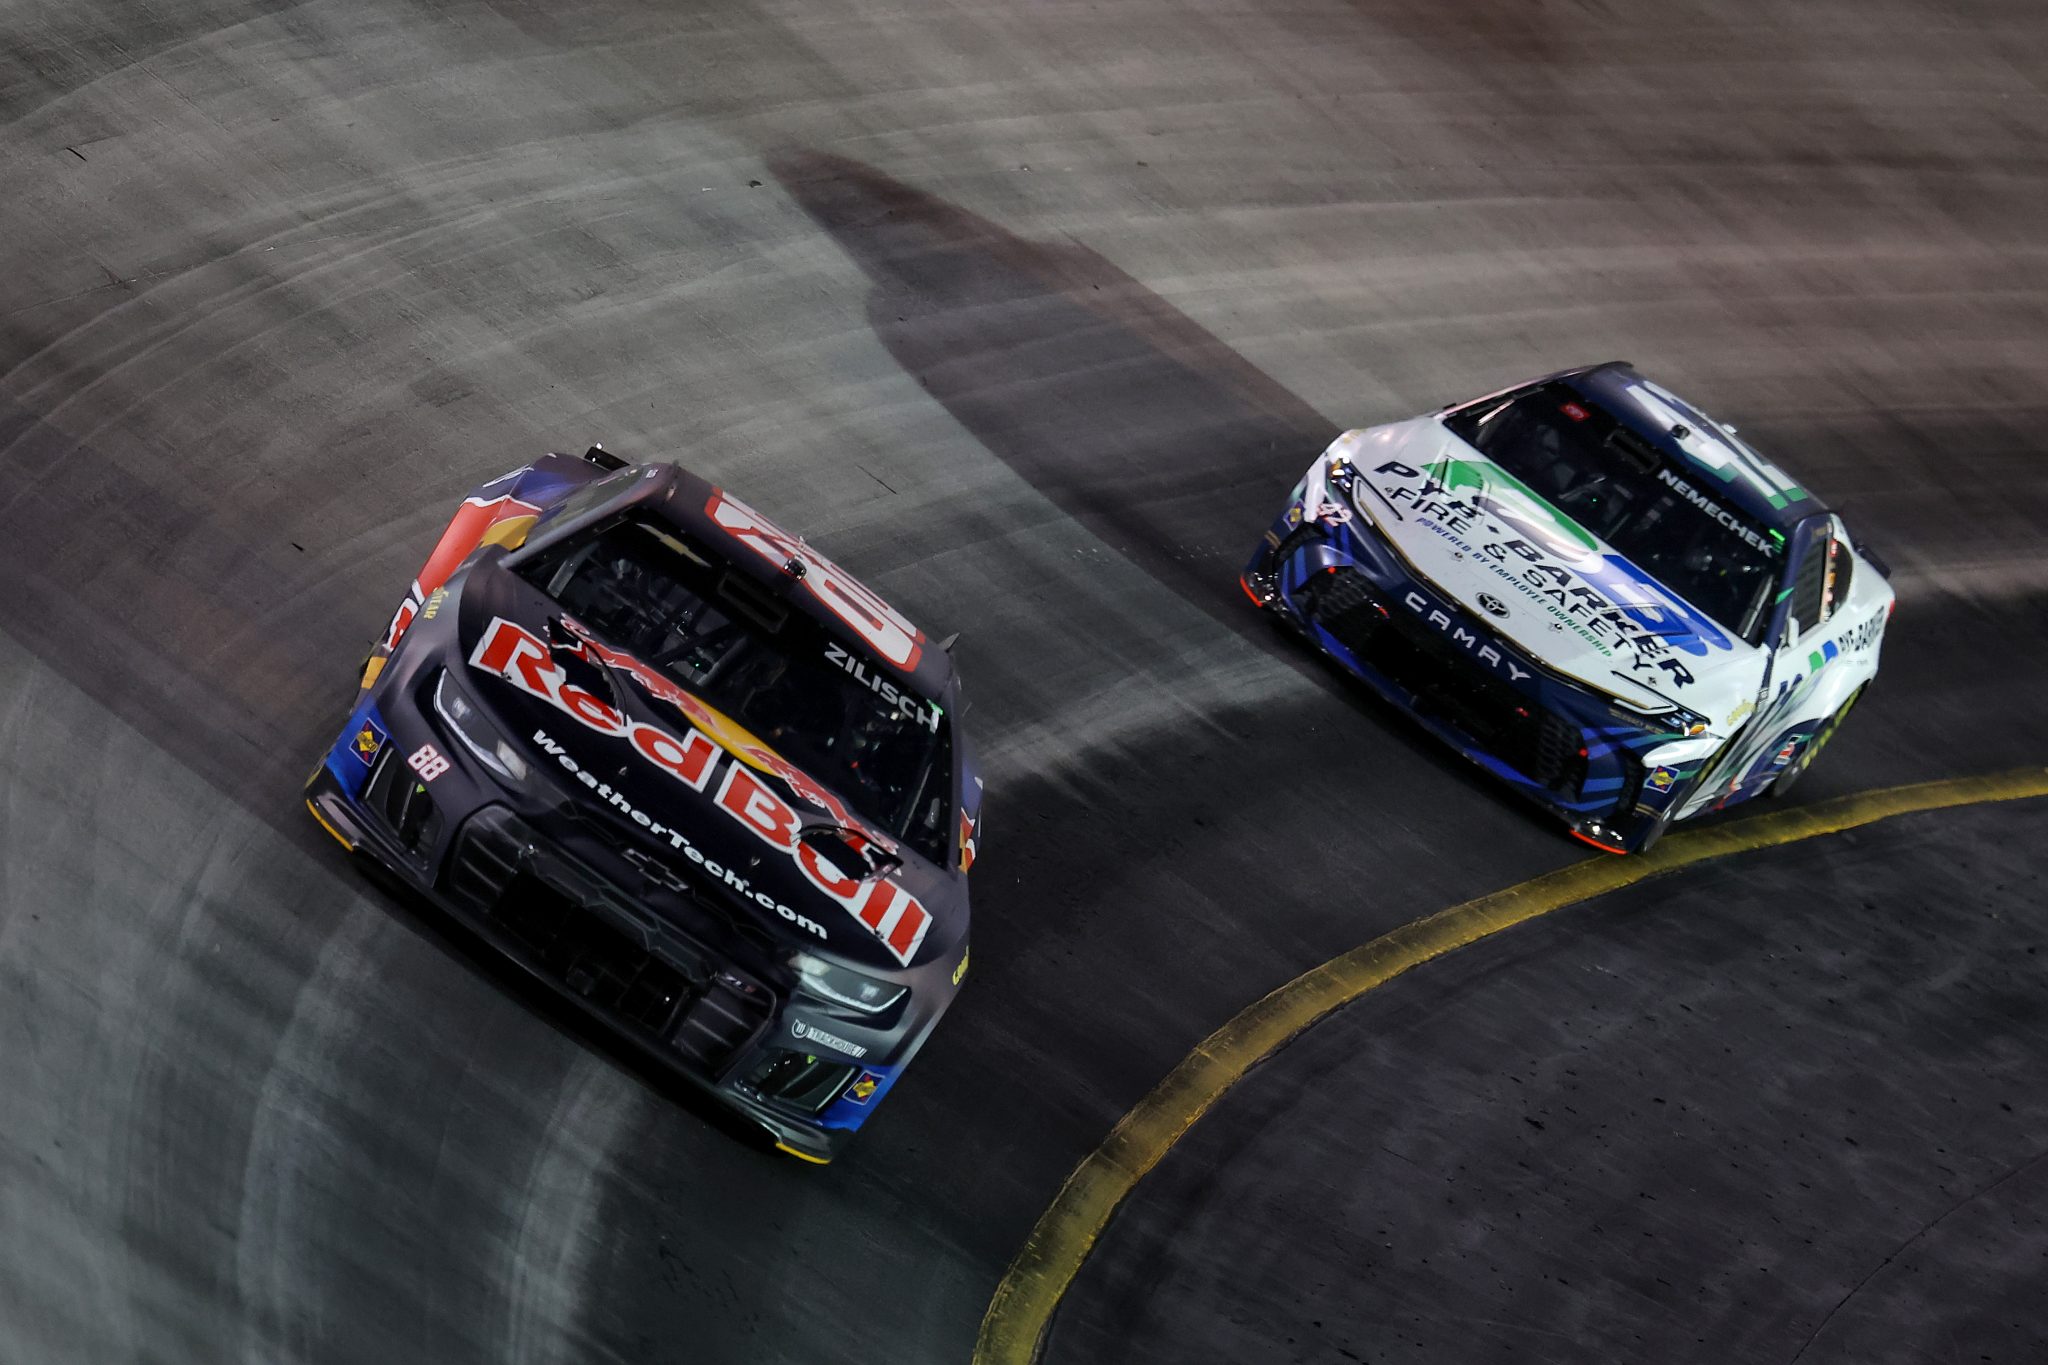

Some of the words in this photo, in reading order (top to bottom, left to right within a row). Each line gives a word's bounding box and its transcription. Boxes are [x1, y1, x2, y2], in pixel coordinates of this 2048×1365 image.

[1657, 468, 1774, 558] NEMECHEK
[1390, 487, 1472, 535] FIRE
[1483, 543, 1507, 563] &
[1522, 569, 1653, 671] SAFETY
[1415, 517, 1472, 552] POWERED
[1472, 552, 1490, 563] BY
[1489, 564, 1546, 604] EMPLOYEE
[1547, 605, 1612, 658] OWNERSHIP
[1405, 591, 1531, 681] CAMRY
[824, 641, 941, 735] ZILISCH
[407, 743, 451, 782] 88
[533, 729, 828, 940] WeatherTech.com
